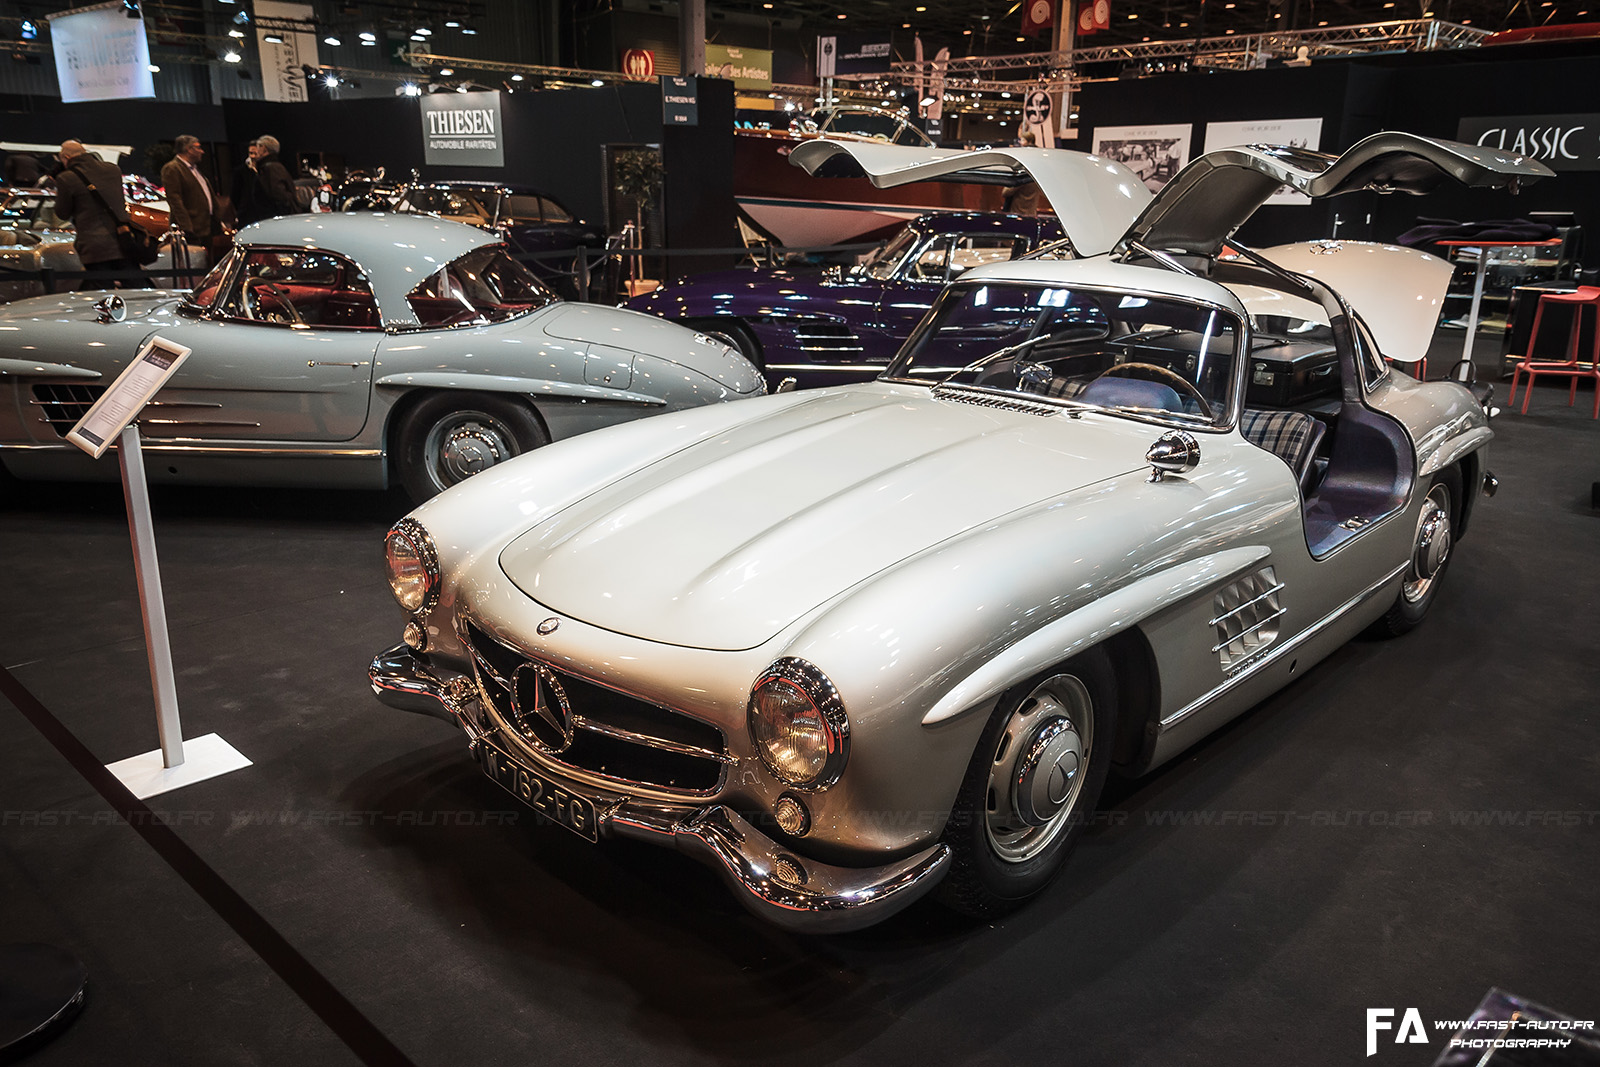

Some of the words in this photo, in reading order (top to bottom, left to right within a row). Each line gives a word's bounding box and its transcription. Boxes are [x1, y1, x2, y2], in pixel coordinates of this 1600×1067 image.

[742, 66, 769, 80] Artistes
[427, 109, 495, 134] THIESEN
[430, 140, 464, 150] AUTOMOBILE
[1477, 126, 1584, 160] CLASSIC
